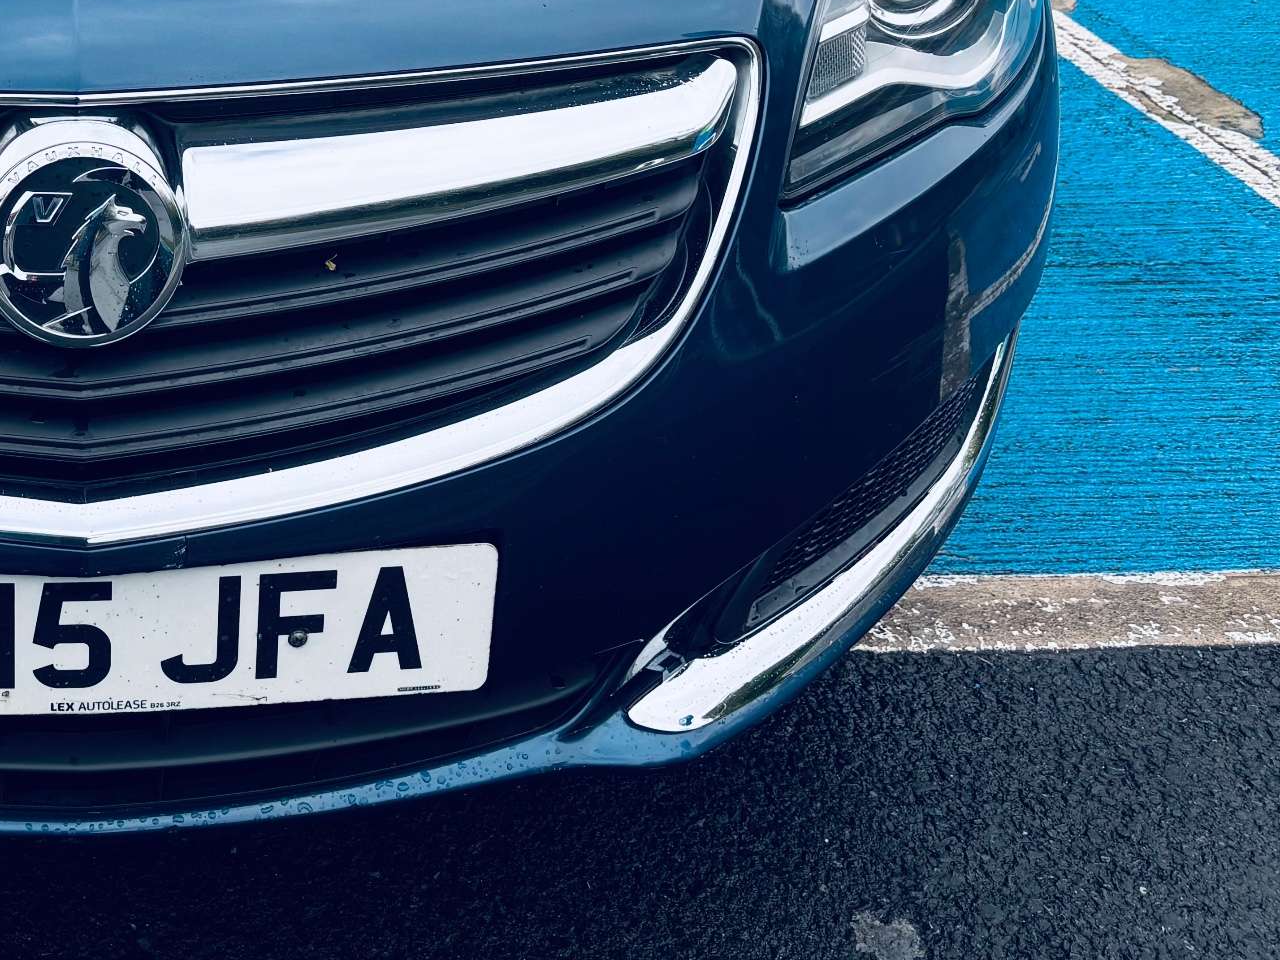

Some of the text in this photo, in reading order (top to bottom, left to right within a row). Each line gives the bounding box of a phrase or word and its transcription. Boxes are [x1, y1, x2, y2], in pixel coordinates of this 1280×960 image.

[7, 145, 158, 187] VAUXHALL
[160, 565, 423, 684] JFA
[50, 702, 74, 712] LEX
[78, 699, 148, 712] AUTOLEASE
